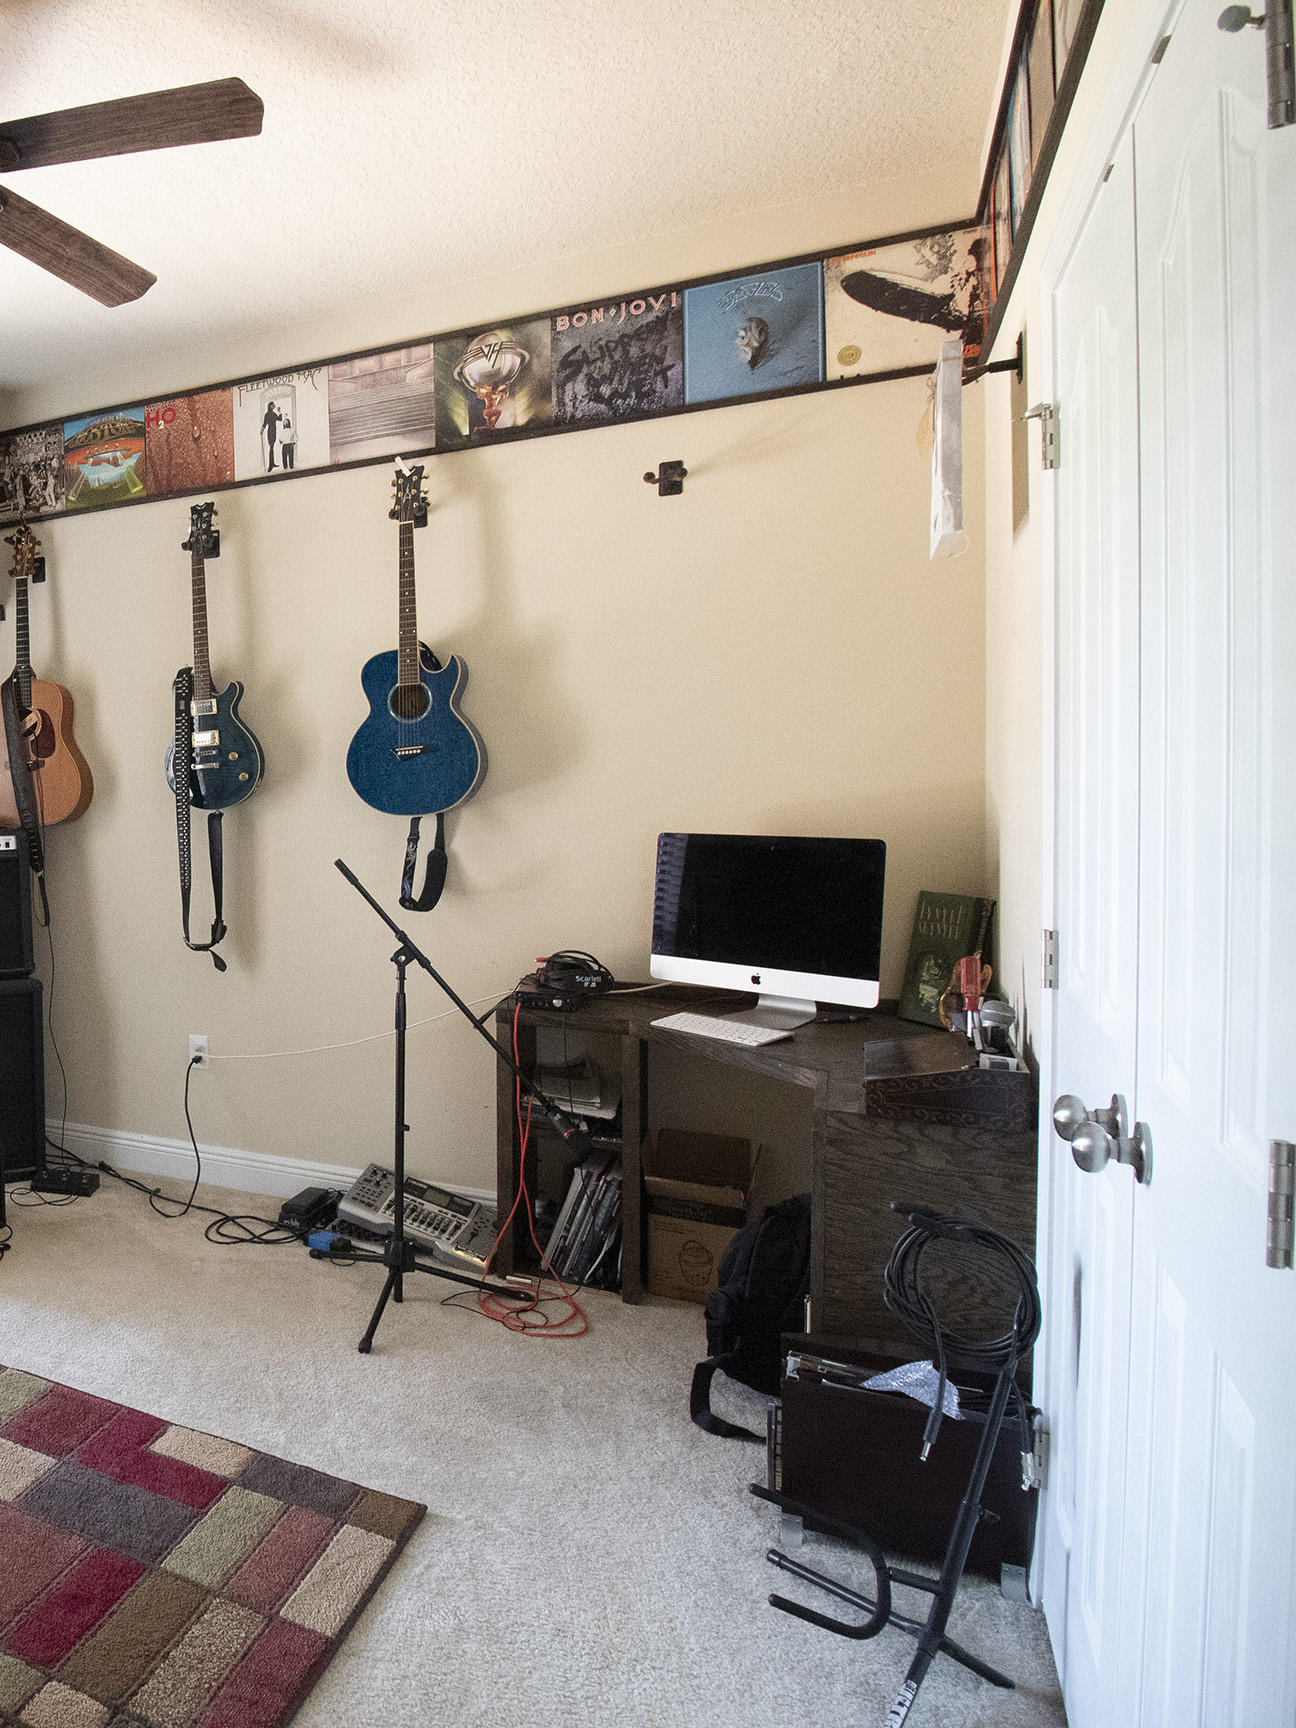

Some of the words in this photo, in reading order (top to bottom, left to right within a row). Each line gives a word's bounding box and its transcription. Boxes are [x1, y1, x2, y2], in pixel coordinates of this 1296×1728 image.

[556, 307, 604, 332] BON
[618, 291, 678, 325] JOVI
[238, 374, 294, 408] FLEETWOOD
[296, 368, 322, 391] MAC
